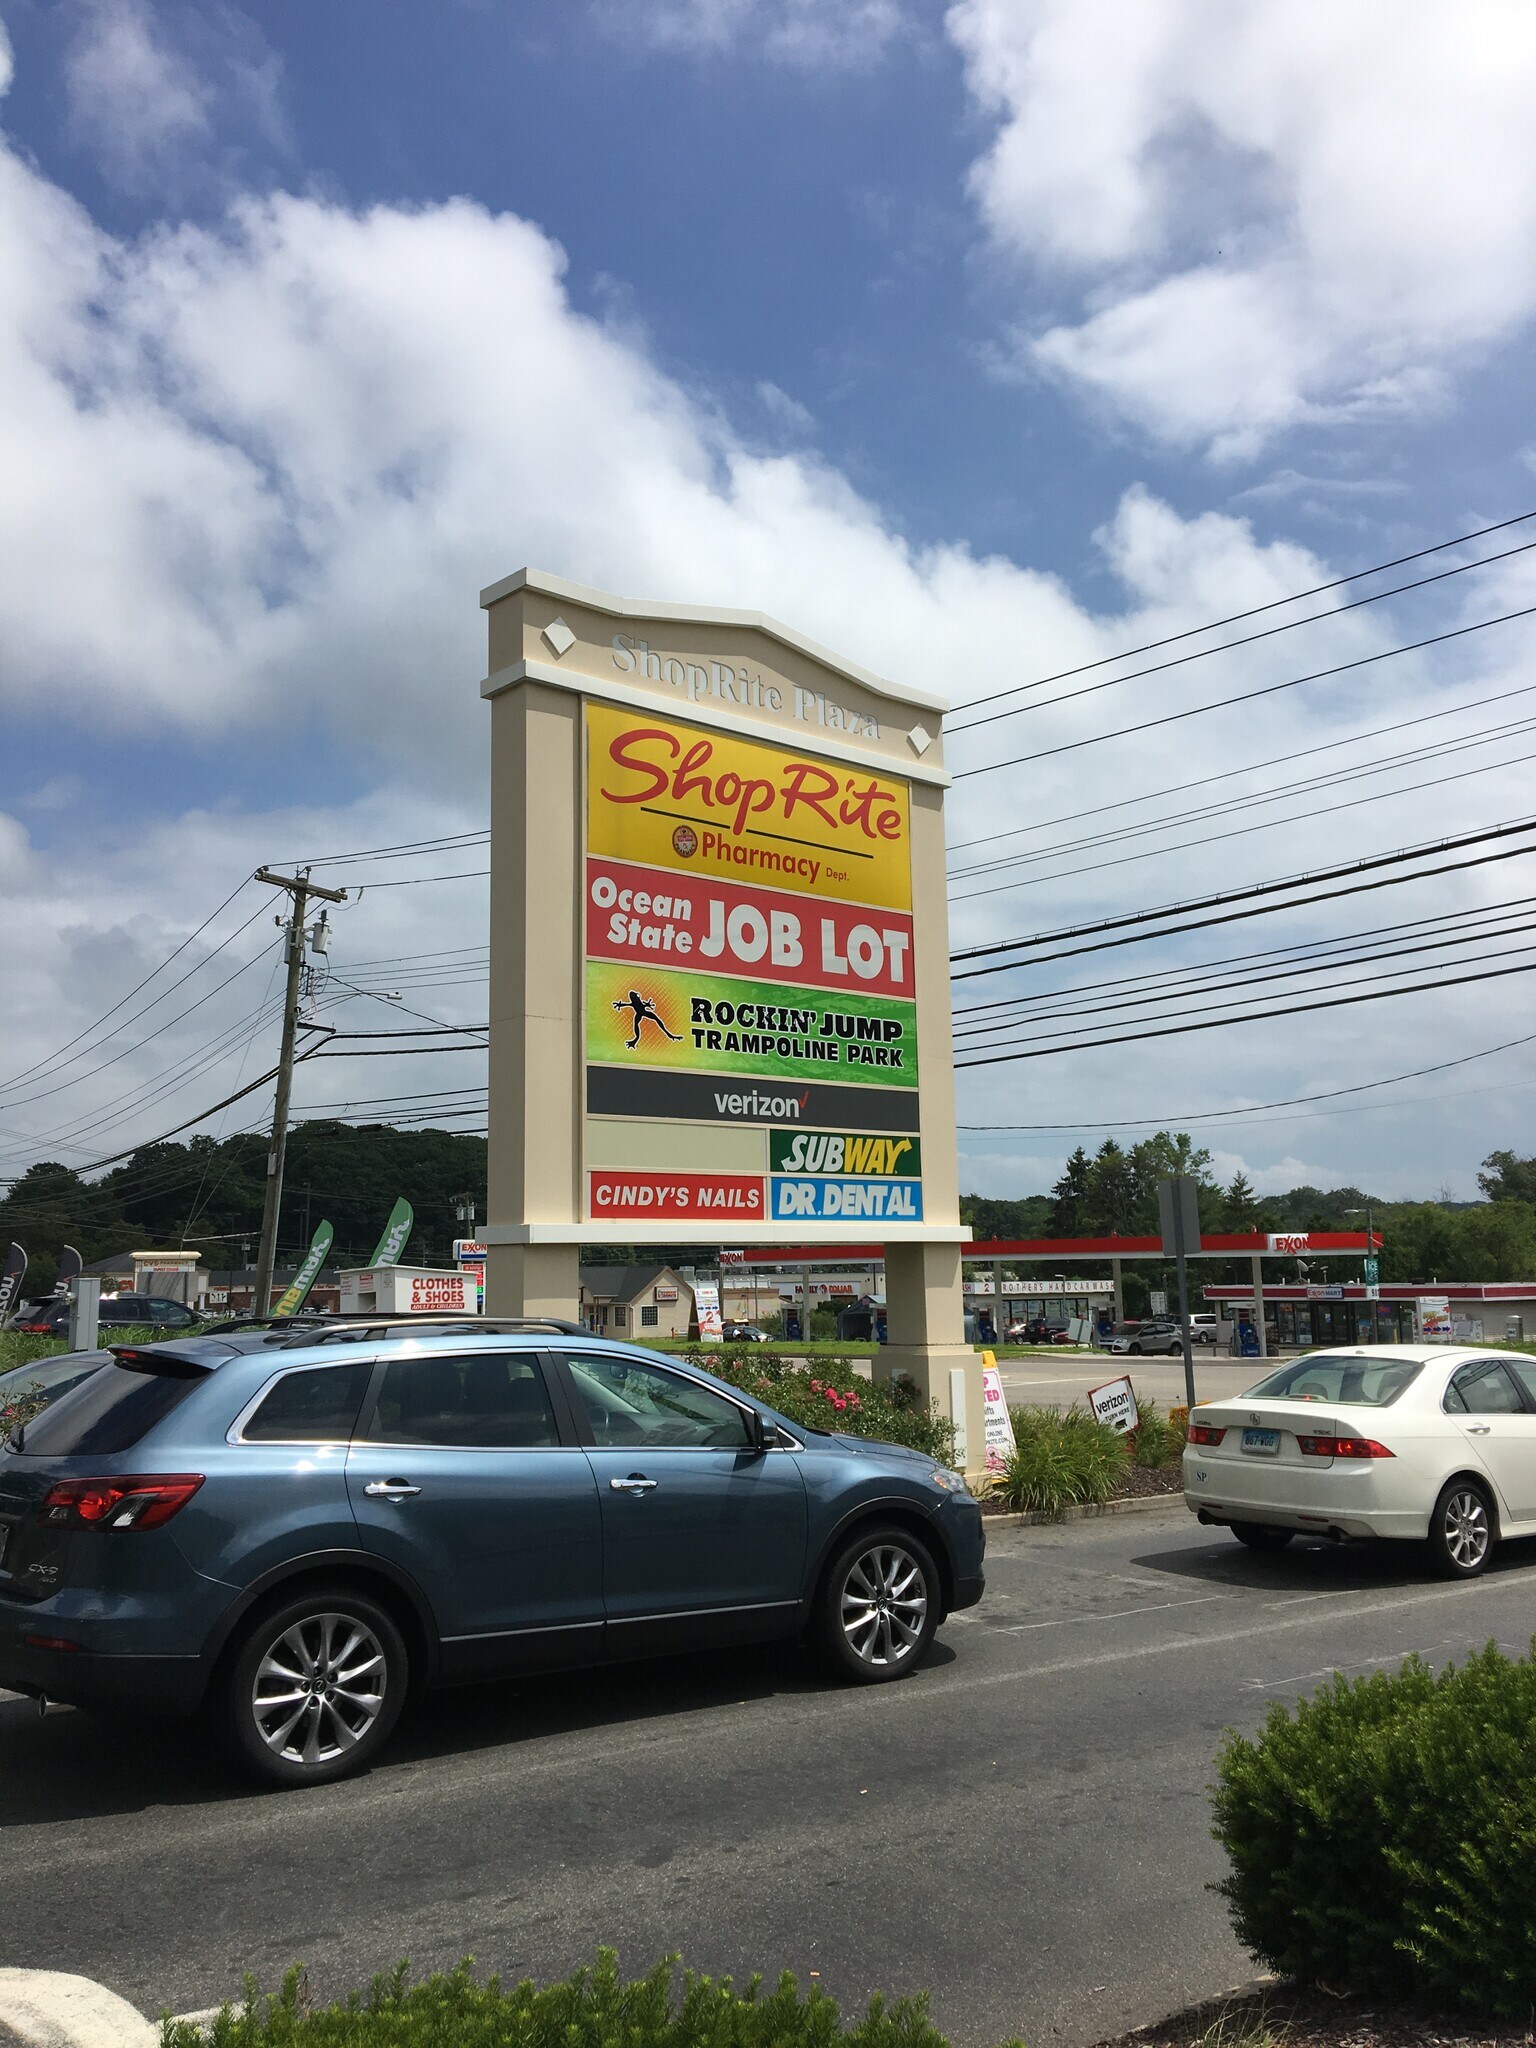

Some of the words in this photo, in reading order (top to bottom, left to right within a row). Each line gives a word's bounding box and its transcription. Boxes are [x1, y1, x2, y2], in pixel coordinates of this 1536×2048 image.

[610, 632, 783, 714] ShopRite
[793, 683, 882, 741] Plaza
[600, 728, 902, 841] ShopRite
[702, 831, 821, 885] Pharmacy
[825, 867, 851, 882] Dept.
[591, 876, 693, 921] Ocean
[606, 912, 694, 953] State
[699, 899, 804, 968] JOB
[820, 918, 909, 983] LOT
[690, 996, 817, 1035] ROCKIN'
[819, 1013, 904, 1044] JUMP
[691, 1028, 839, 1062] TRAMPOLINE
[846, 1044, 905, 1068] PARK
[714, 1089, 800, 1118] verizon
[781, 1134, 913, 1173] SUBWAY
[595, 1184, 690, 1208] CINDY'S
[697, 1187, 760, 1209] NAILS
[462, 1242, 488, 1254] EXXON
[1276, 1235, 1309, 1255] EXXON
[412, 1277, 464, 1290] CLOTHES
[412, 1292, 421, 1303] &
[425, 1290, 464, 1303] SHOES
[795, 1285, 818, 1294] FAILY
[984, 1283, 990, 1292] 2
[1002, 1282, 1043, 1292] ROTHERS
[1095, 1392, 1129, 1415] verizon
[1105, 1412, 1118, 1421] TURN
[1118, 1407, 1130, 1417] HERE
[1196, 1471, 1208, 1482] SP
